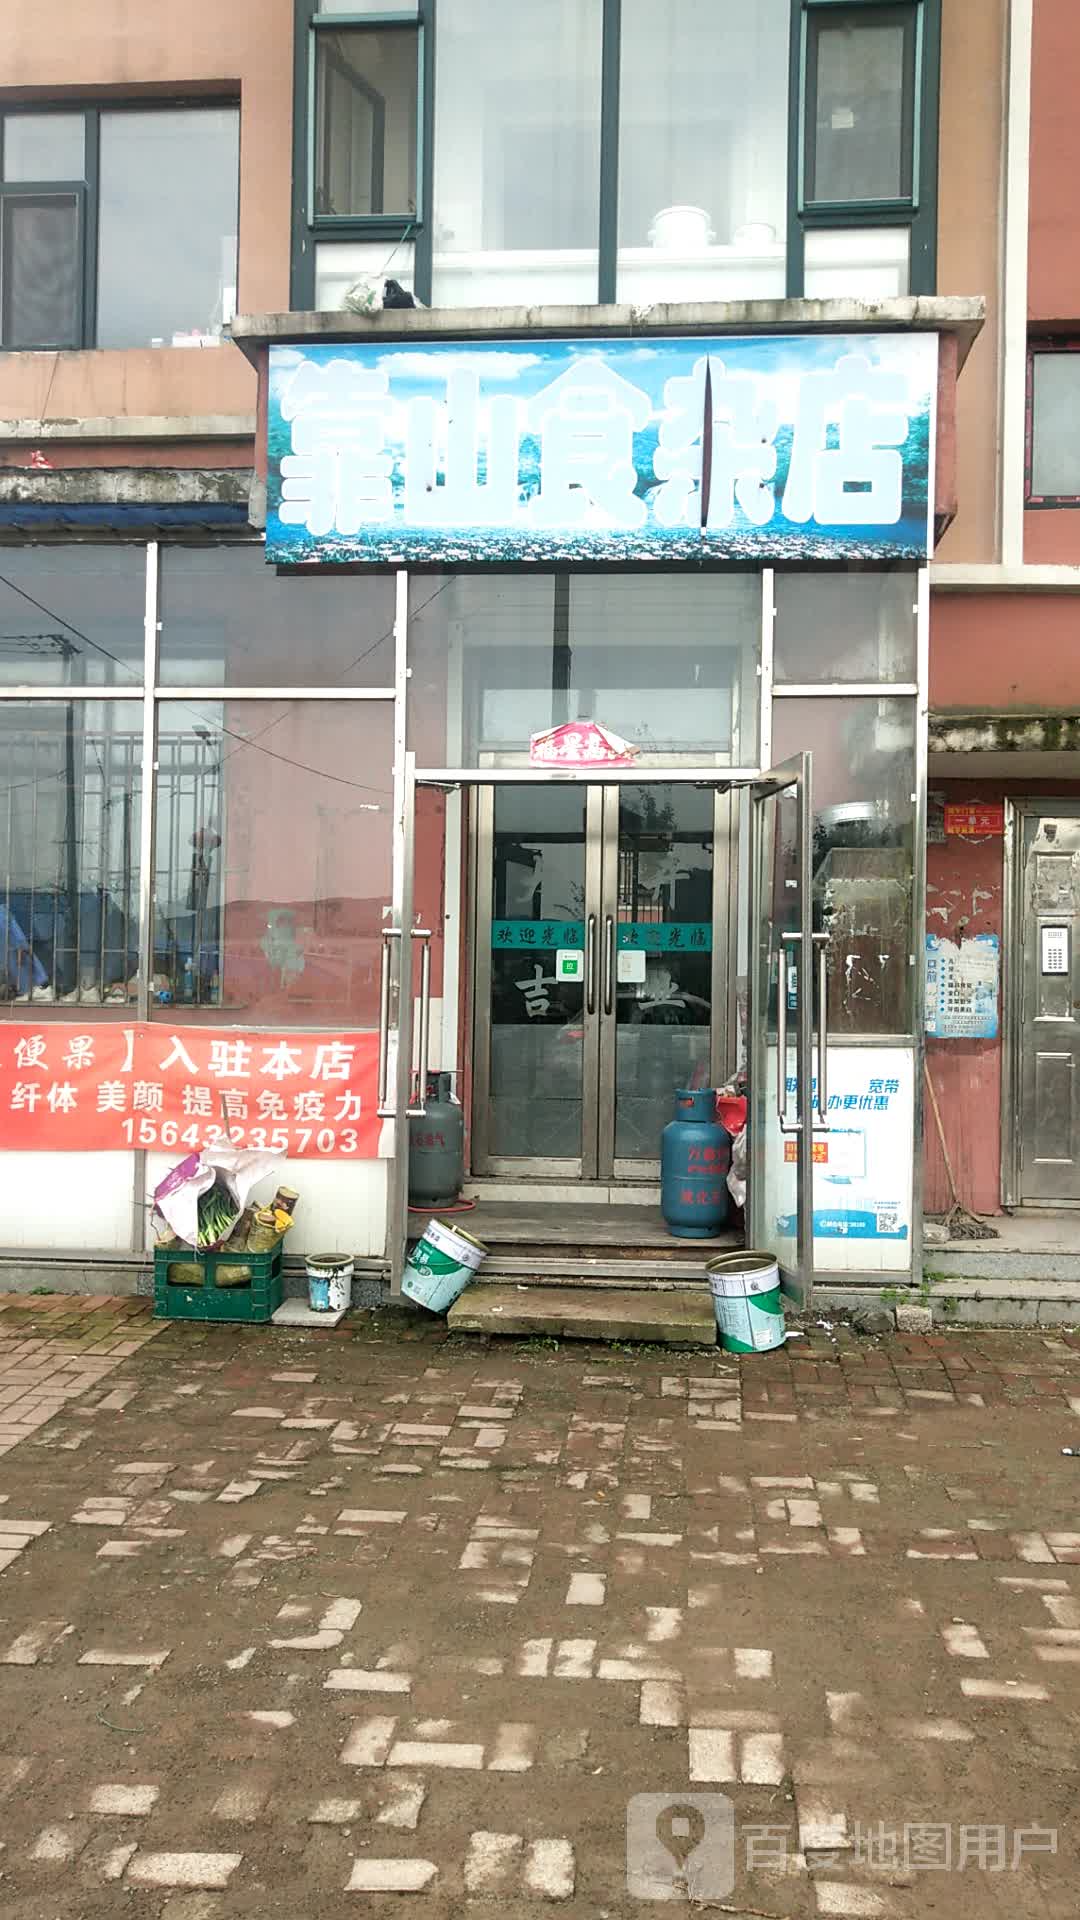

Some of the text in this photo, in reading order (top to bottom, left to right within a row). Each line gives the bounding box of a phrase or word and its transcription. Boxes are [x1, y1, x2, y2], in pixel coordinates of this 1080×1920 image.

[278, 354, 910, 538] 靠山食杂店
[497, 927, 579, 946] 欢迎光临
[10, 1080, 362, 1122] 纤体 美颜 提高免疫力
[868, 1078, 900, 1094] 宽带
[121, 1117, 358, 1154] 15643235703
